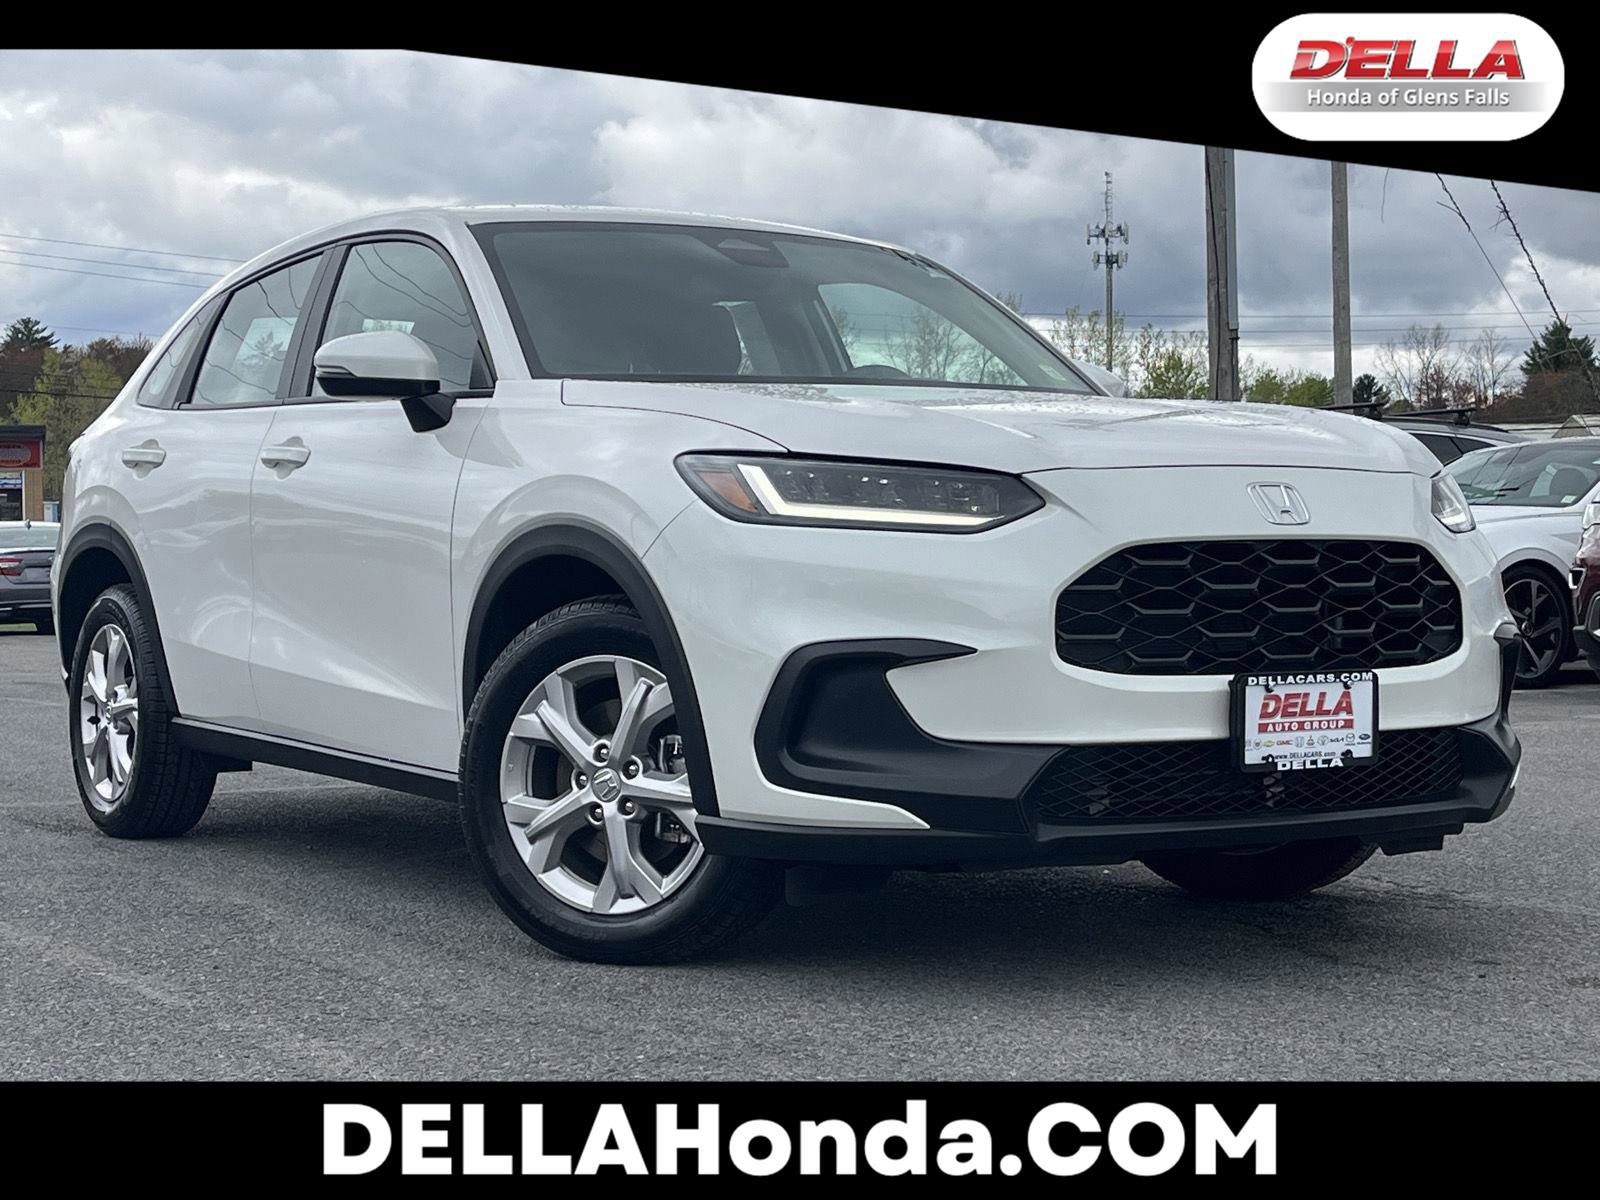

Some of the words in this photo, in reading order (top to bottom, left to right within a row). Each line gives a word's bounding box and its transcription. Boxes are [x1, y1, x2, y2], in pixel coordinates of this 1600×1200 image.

[1247, 671, 1373, 686] DELLACARS.COM
[1259, 690, 1354, 720] DELLA
[1266, 722, 1298, 732] AUTO
[1304, 719, 1345, 730] GROUP
[1277, 758, 1344, 771] DELLA
